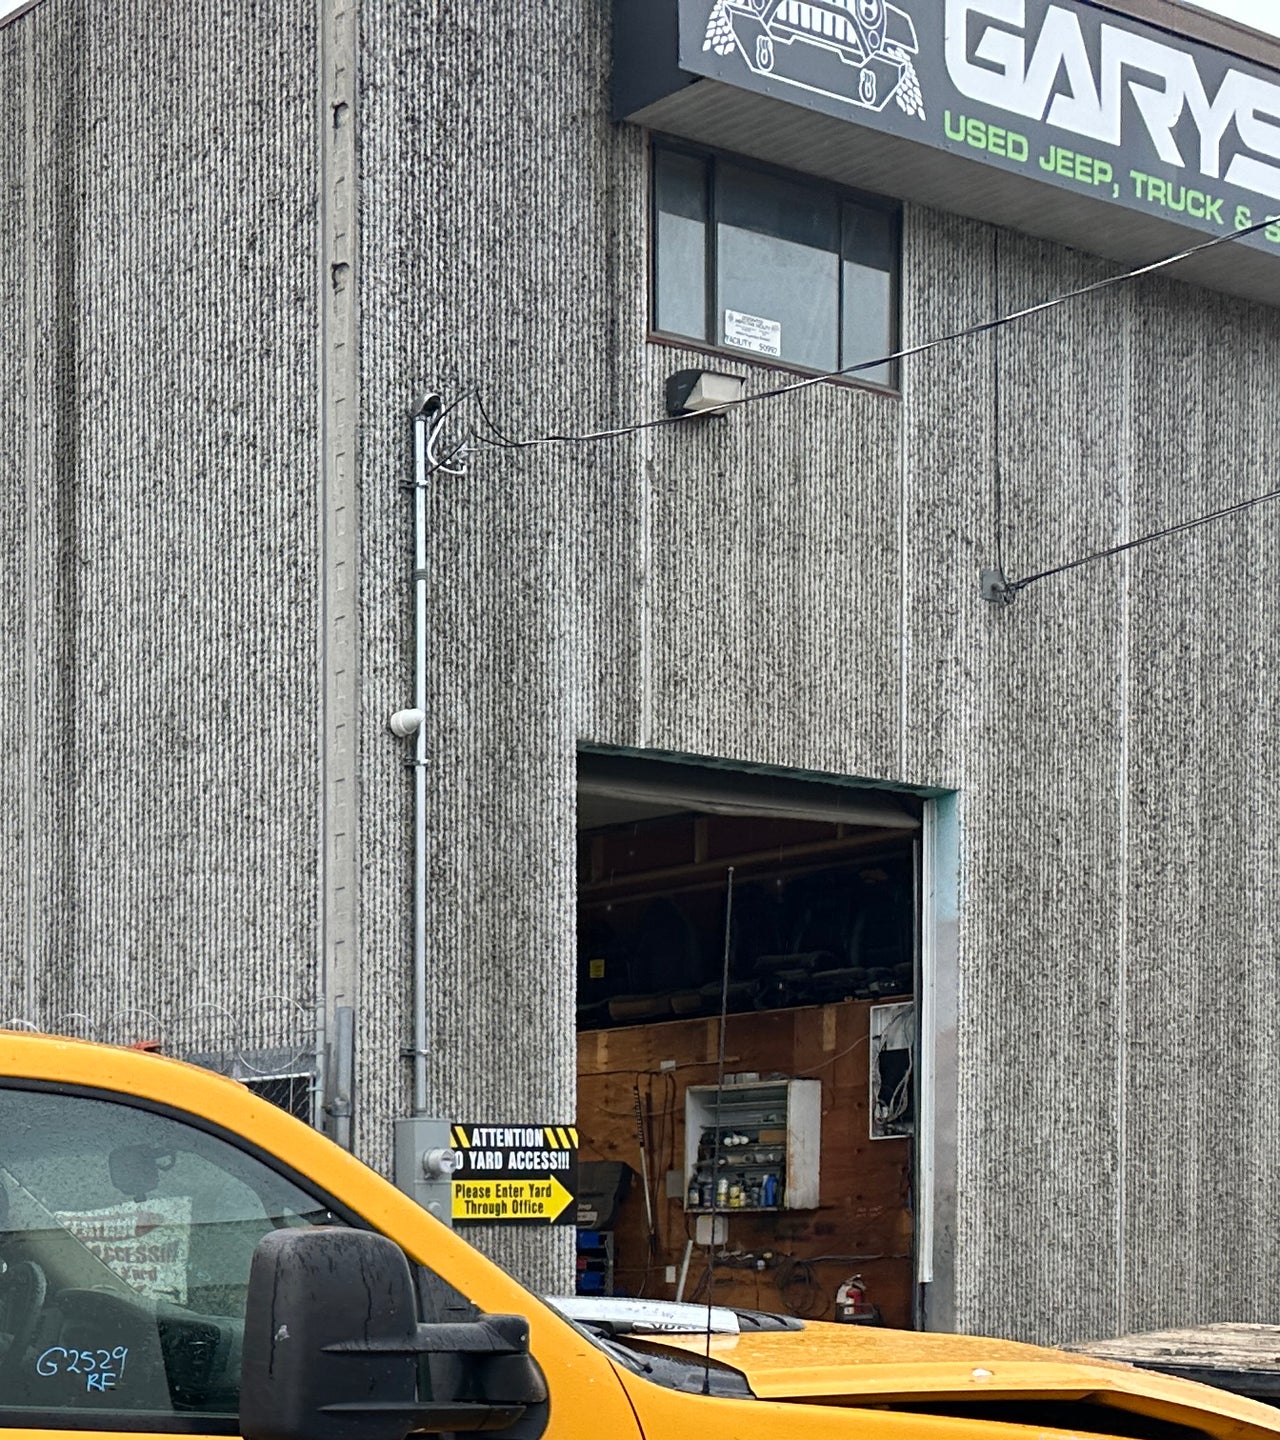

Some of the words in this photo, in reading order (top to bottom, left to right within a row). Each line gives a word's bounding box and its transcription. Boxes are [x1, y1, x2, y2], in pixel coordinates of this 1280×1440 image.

[943, 109, 1029, 163] USED
[1038, 144, 1121, 199] JEEP,
[1129, 169, 1225, 225] TRUCK
[1234, 204, 1253, 232] &
[471, 1127, 544, 1148] ATTENTION
[468, 1150, 503, 1170] YARD
[507, 1150, 570, 1170] ACCESS!!!
[455, 1183, 491, 1199] Please
[495, 1183, 525, 1198] Enter
[528, 1183, 552, 1198] Yard
[464, 1199, 507, 1217] Through
[511, 1199, 544, 1214] Office
[36, 1346, 129, 1378] G2529
[86, 1373, 117, 1392] RF
